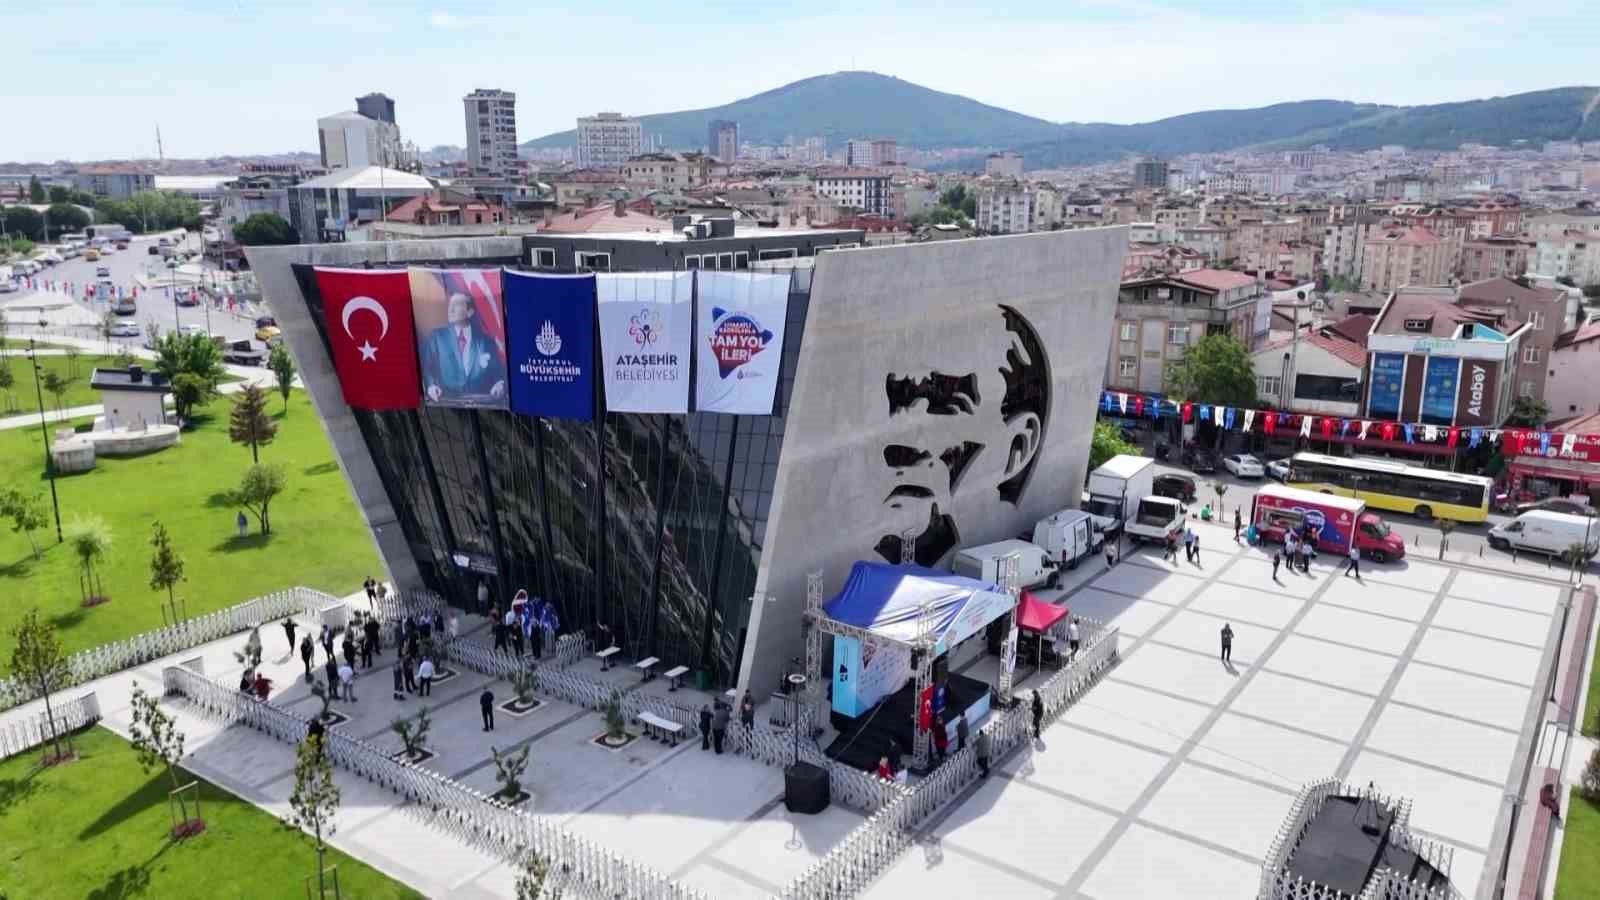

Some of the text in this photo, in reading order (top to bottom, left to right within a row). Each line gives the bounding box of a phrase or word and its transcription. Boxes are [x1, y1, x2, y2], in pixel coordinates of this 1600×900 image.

[710, 335, 766, 349] TAM YOL
[616, 352, 678, 368] ATAŞEHİR
[721, 347, 752, 361] İLERİ
[615, 368, 679, 381] BELEDİYESİ
[1467, 364, 1486, 416] Atabey
